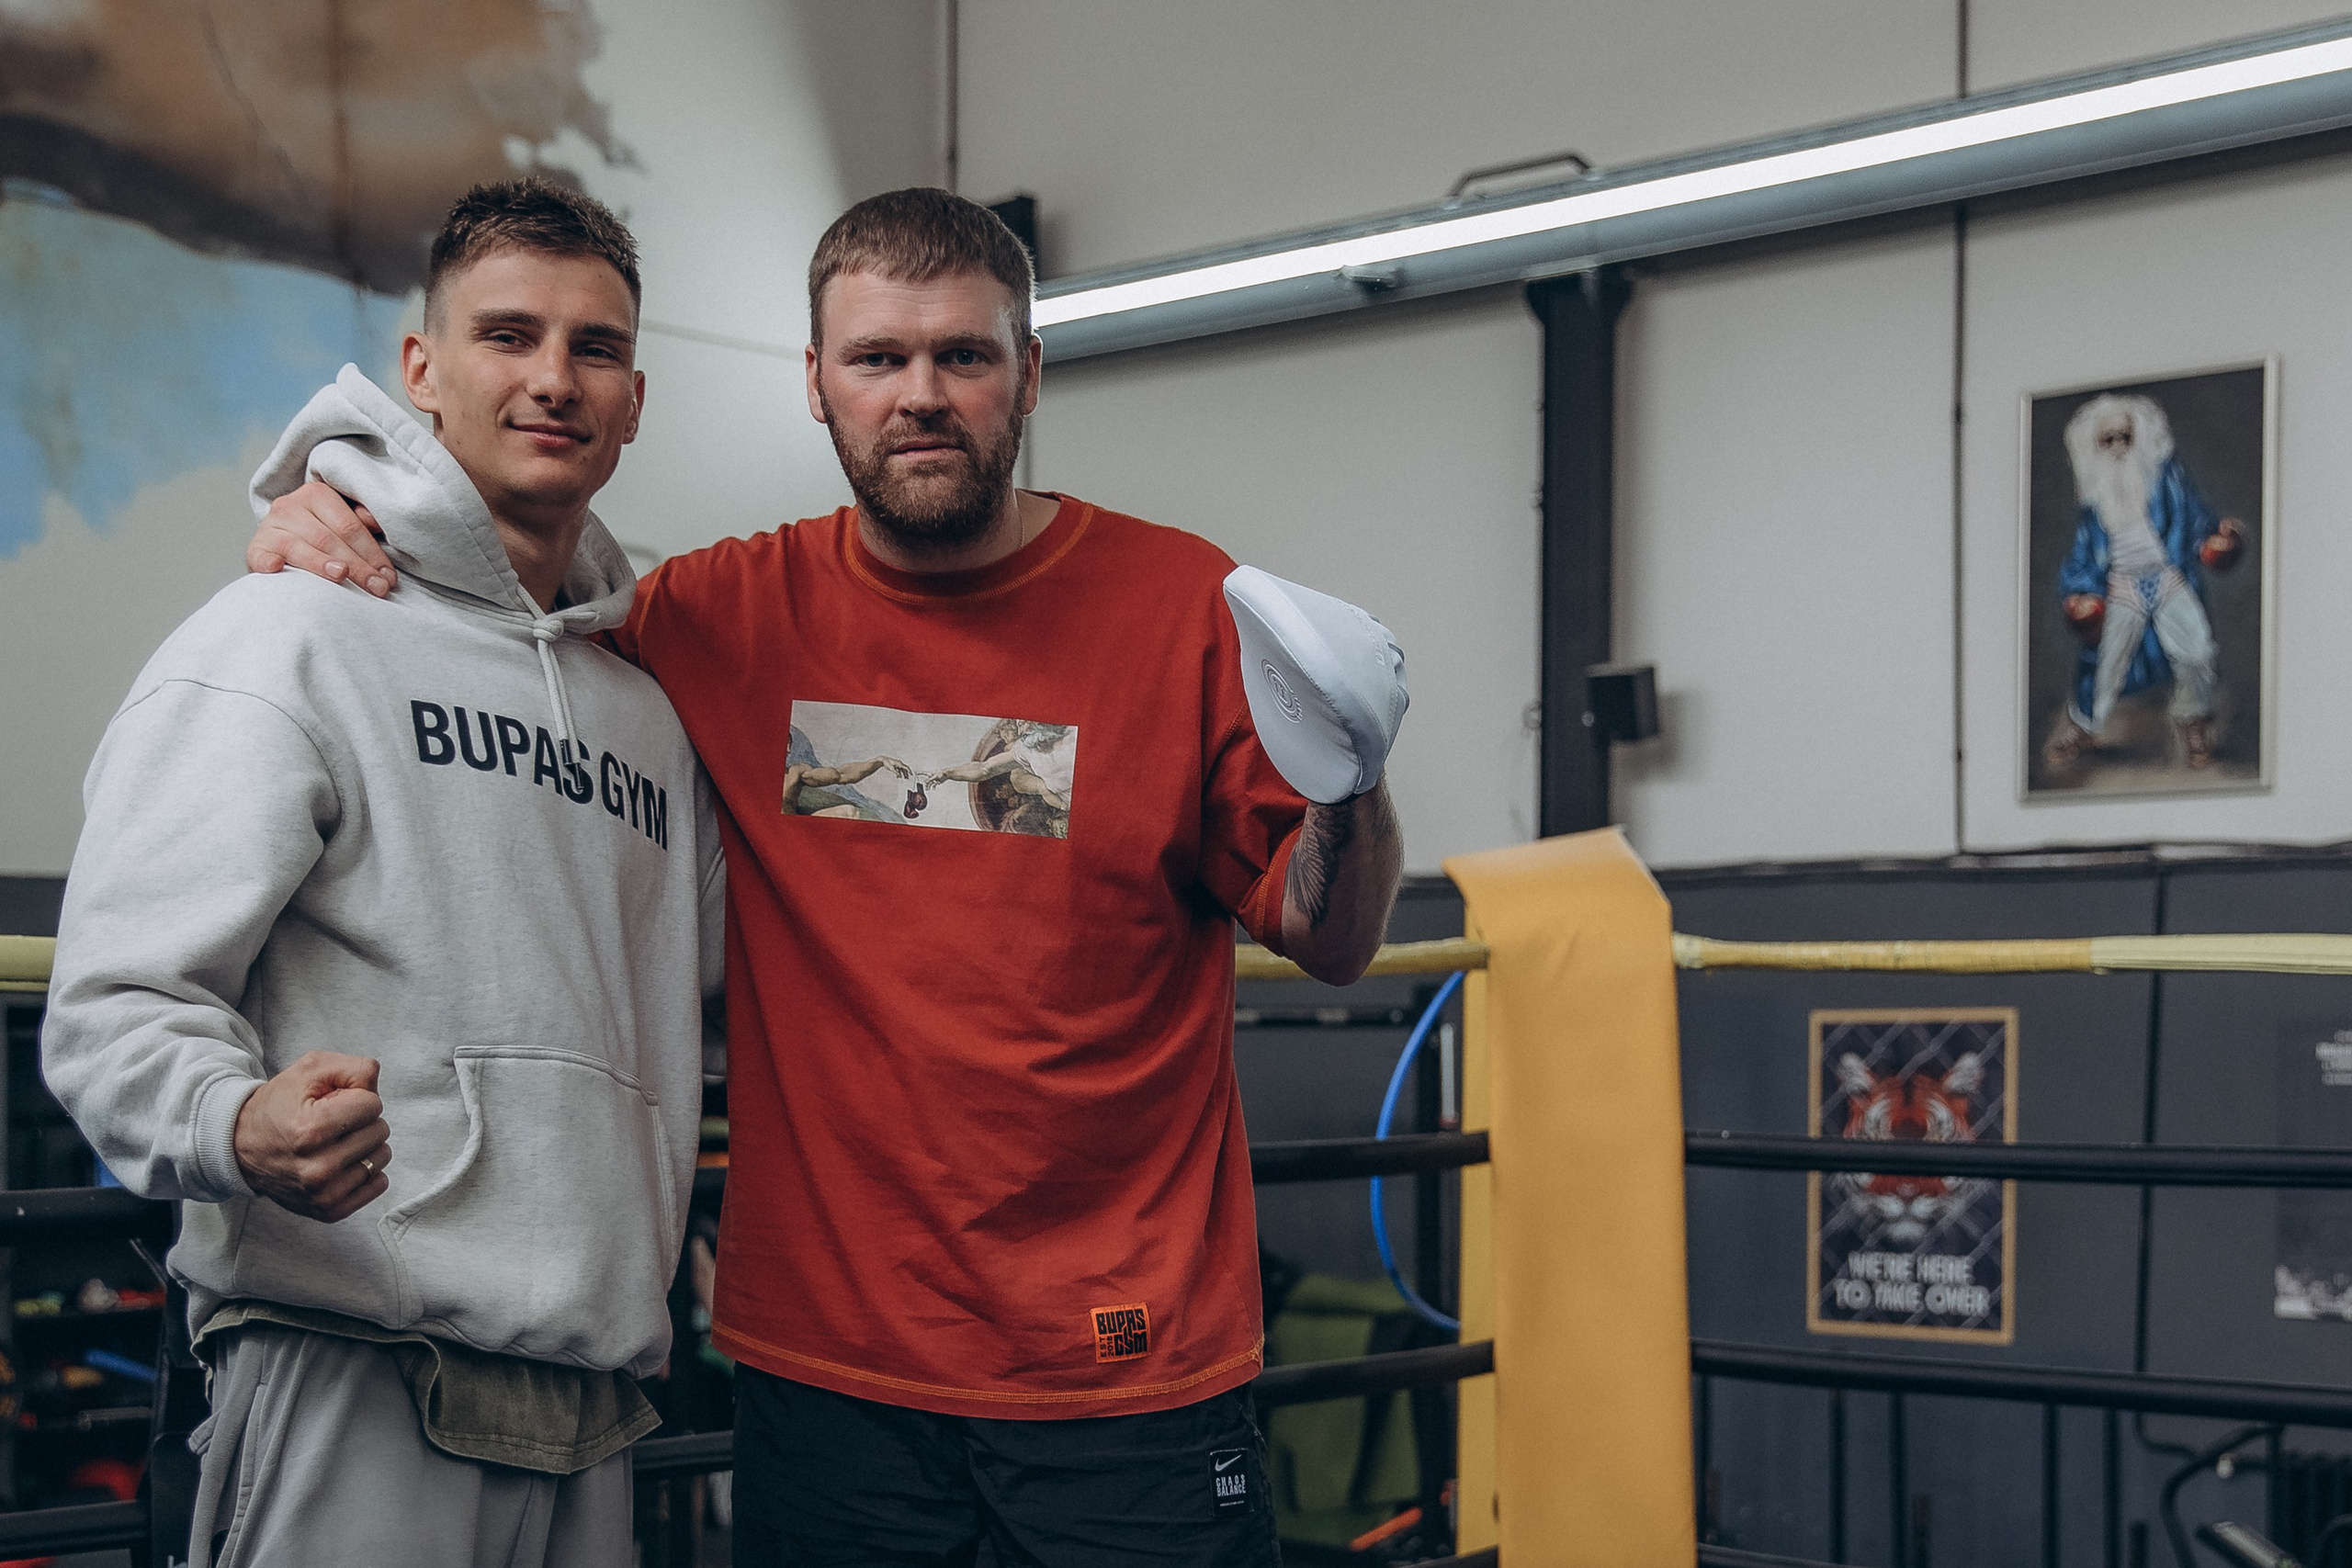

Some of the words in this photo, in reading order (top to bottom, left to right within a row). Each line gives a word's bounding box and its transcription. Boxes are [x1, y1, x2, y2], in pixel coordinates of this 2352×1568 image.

[411, 699, 594, 805] BUPAS
[600, 750, 668, 852] GYM
[1835, 1278, 1872, 1309] TO
[1096, 1308, 1146, 1336] BUPAS
[1216, 1473, 1246, 1487] CHAOS
[1216, 1483, 1247, 1497] BALANCE
